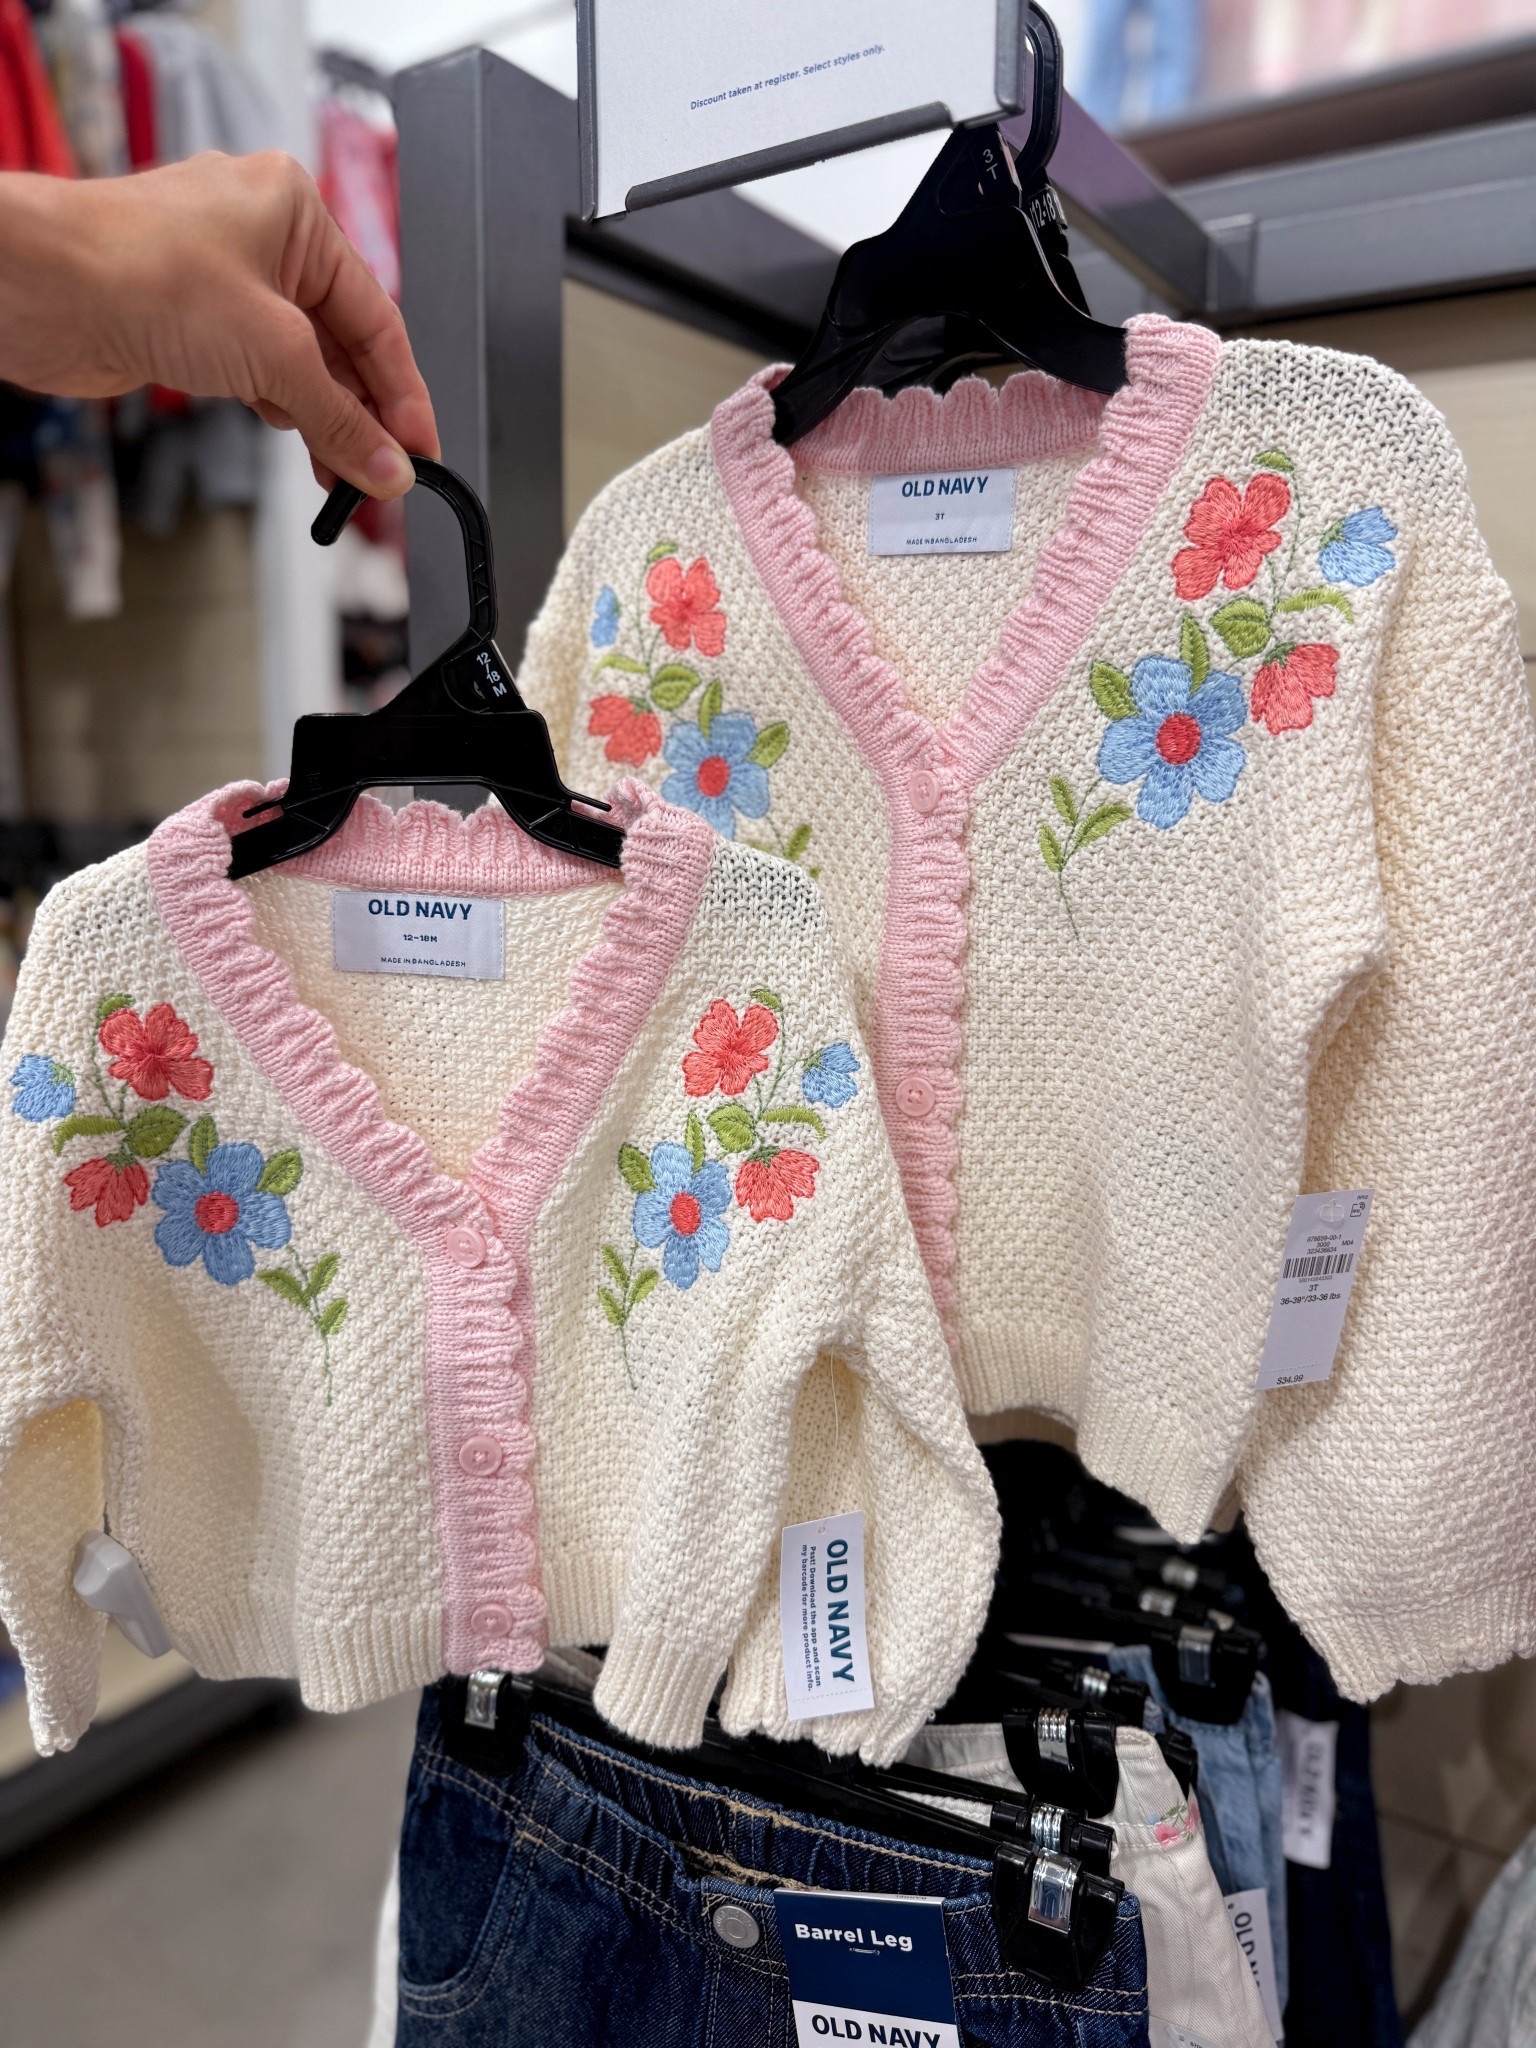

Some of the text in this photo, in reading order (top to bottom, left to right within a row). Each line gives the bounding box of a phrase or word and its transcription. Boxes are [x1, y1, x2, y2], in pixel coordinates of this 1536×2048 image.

[690, 44, 886, 110] Discount taken at register. Select styles only.
[902, 476, 989, 497] OLD NAVY
[935, 512, 945, 521] 3T
[930, 536, 977, 545] BANGLADESH
[368, 898, 472, 920] OLD NAVY
[412, 958, 466, 968] BANGLADESH
[1308, 1284, 1319, 1292] 3T
[1329, 1292, 1341, 1300] lbs
[1276, 1374, 1304, 1385] $34.99
[801, 1544, 808, 1557] my
[809, 1567, 817, 1609] Download
[810, 1611, 818, 1625] the
[826, 1538, 855, 1683] OLD NAVY
[811, 1627, 819, 1644] app
[802, 1632, 812, 1669] product
[812, 1646, 820, 1663] and
[806, 1670, 814, 1692] info.
[814, 1666, 822, 1687] scan
[794, 1923, 913, 1952] Barrel Leg
[811, 2014, 941, 2048] OLD NAVY
